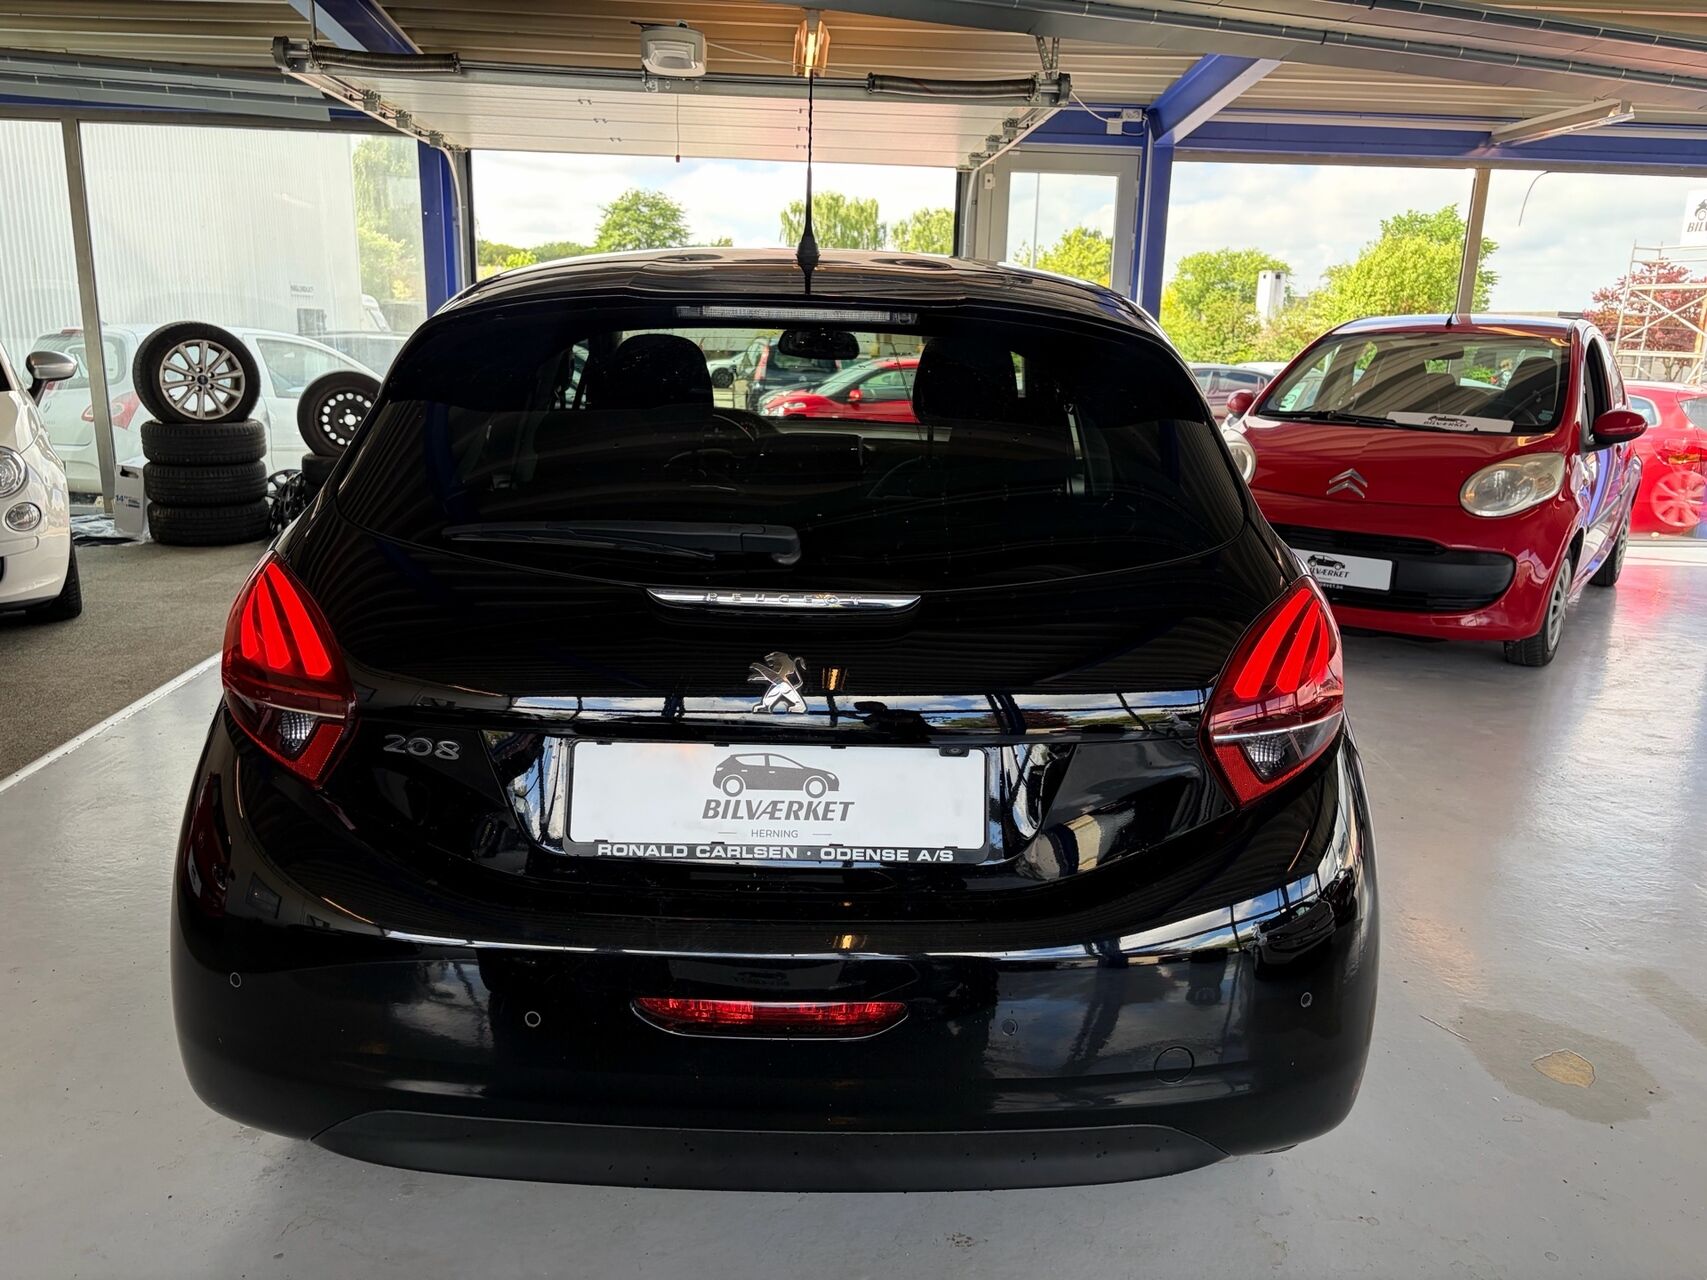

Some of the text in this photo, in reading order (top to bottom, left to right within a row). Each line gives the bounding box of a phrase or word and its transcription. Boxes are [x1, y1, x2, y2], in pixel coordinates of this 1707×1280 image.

[1687, 222, 1707, 232] BIL
[383, 734, 460, 760] 208
[702, 799, 855, 821] BILVÆRKET
[751, 829, 798, 838] HERNING
[597, 843, 954, 862] RONALD CARLSEN ODENSE A/S
